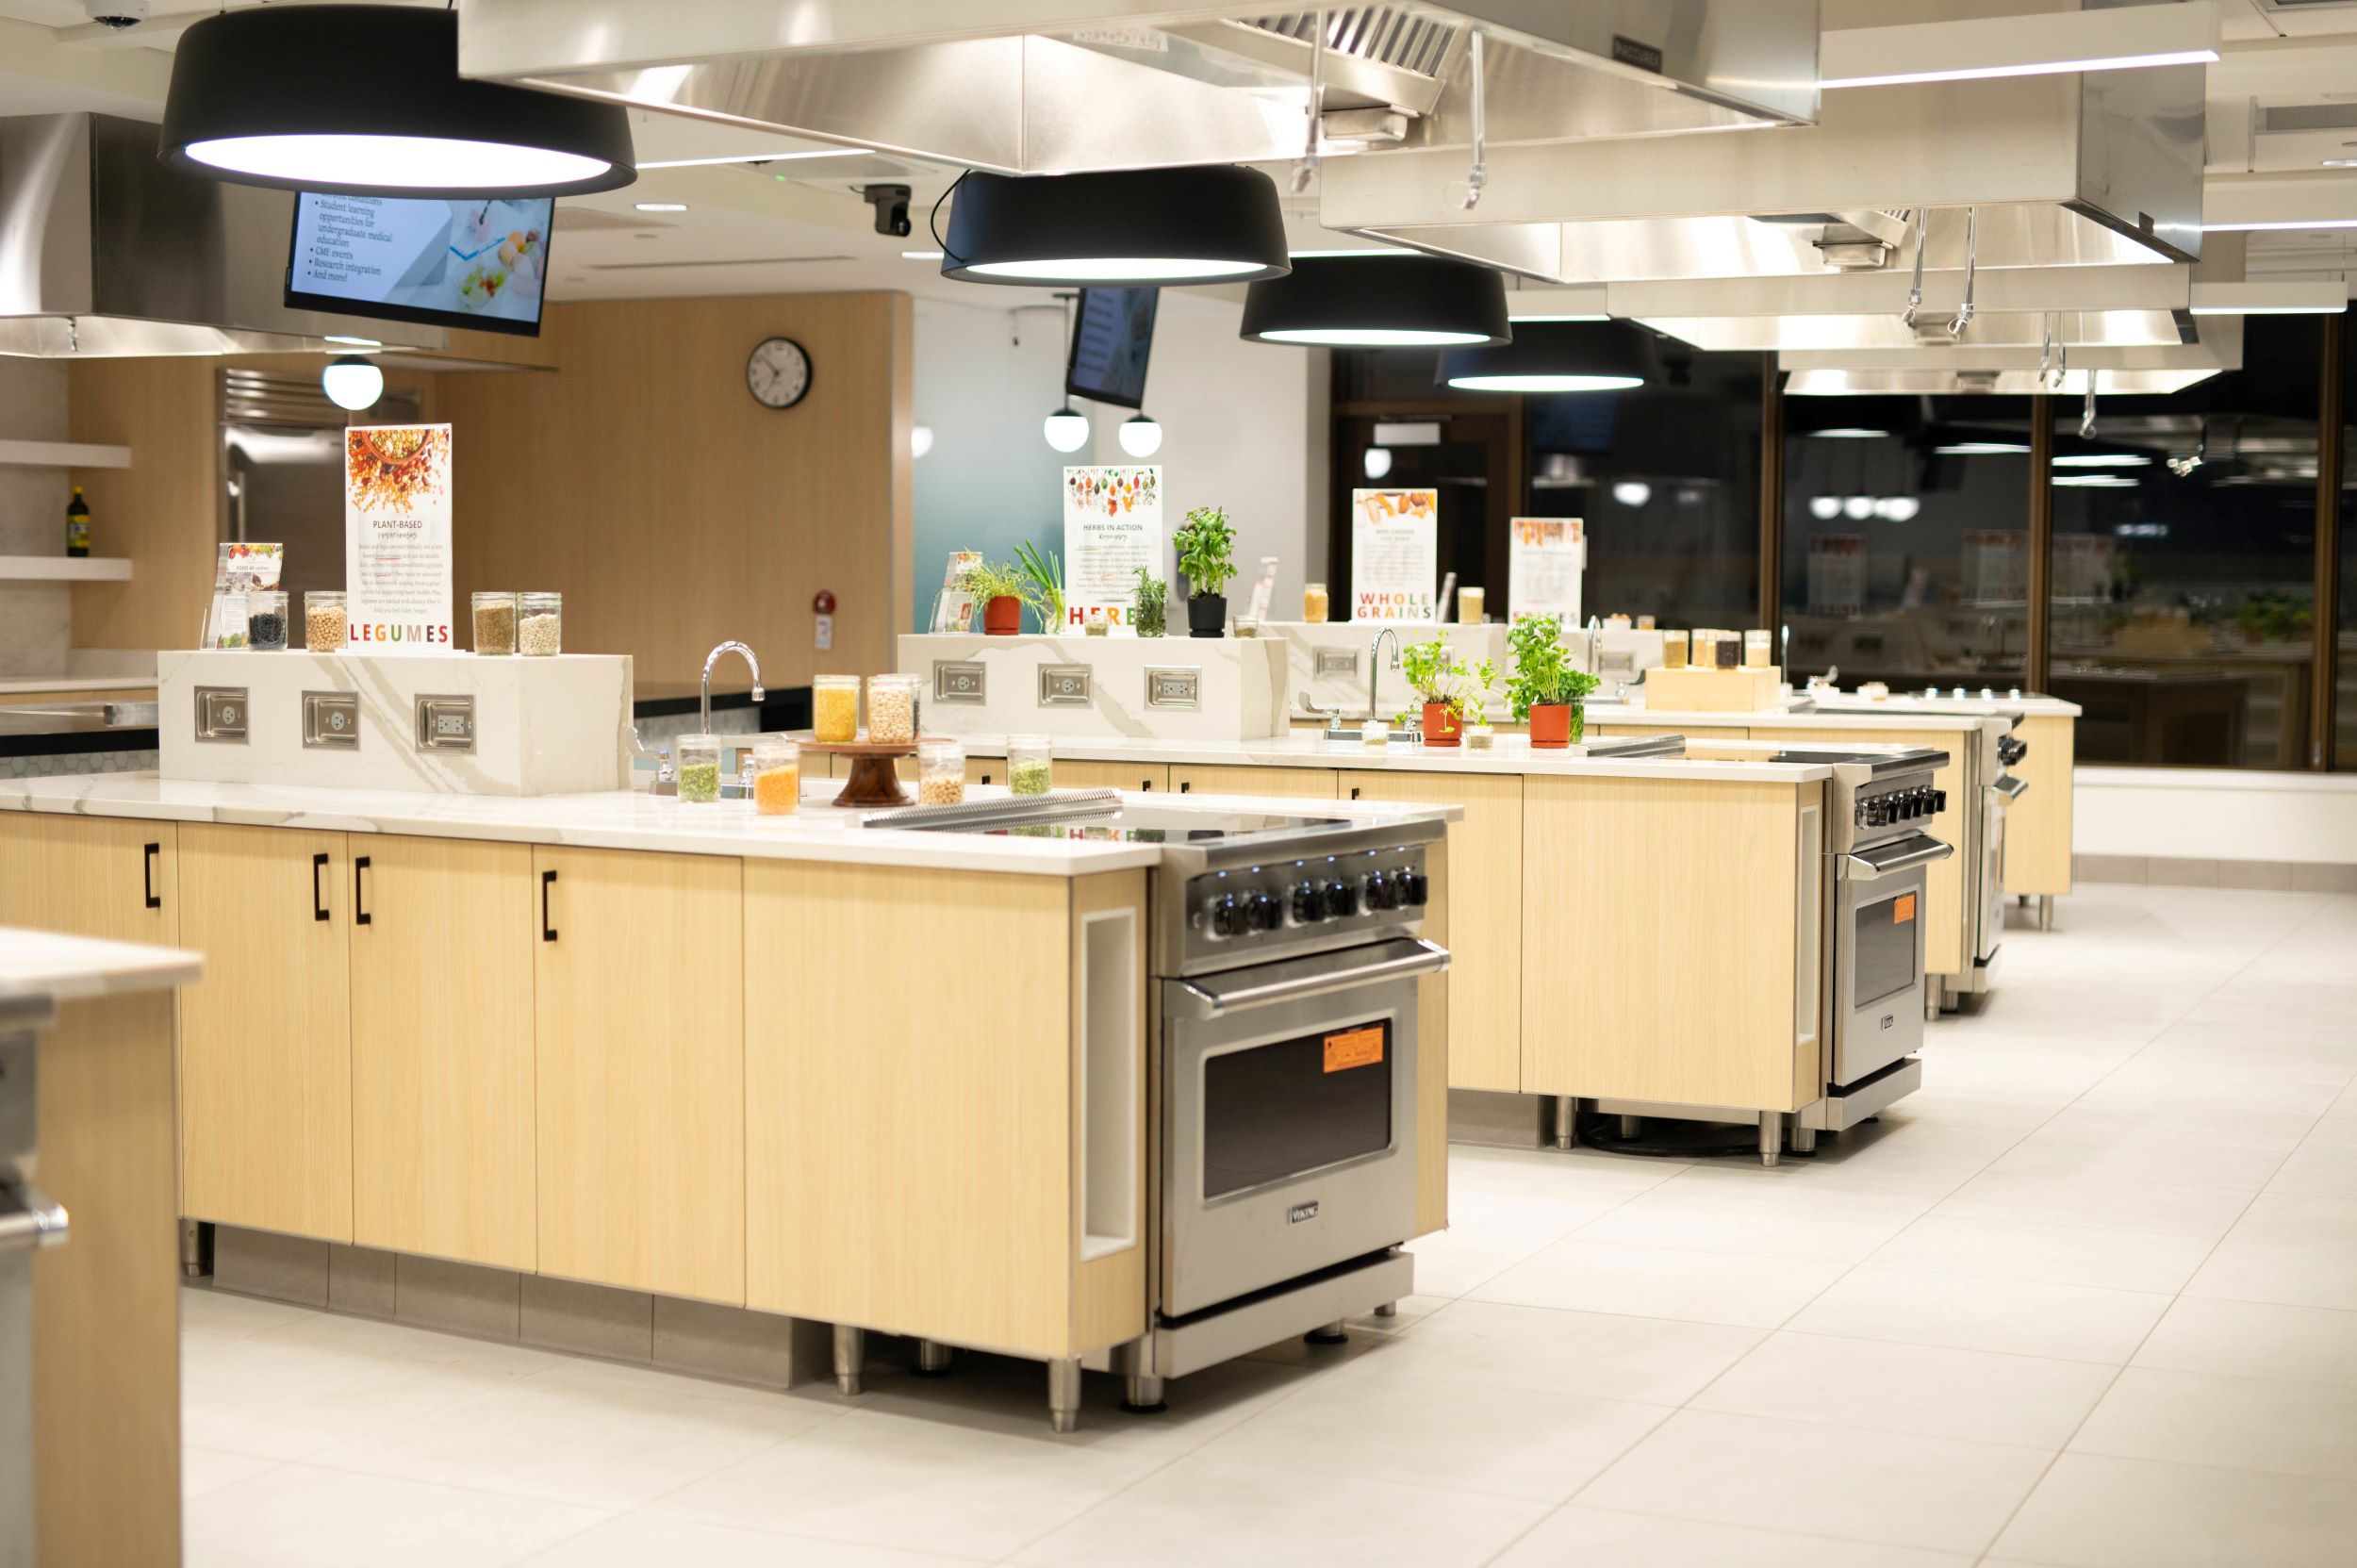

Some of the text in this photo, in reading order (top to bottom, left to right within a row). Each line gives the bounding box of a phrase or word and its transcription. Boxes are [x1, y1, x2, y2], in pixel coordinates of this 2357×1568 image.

[321, 200, 375, 219] Student learning
[319, 212, 375, 227] opportunities for
[318, 224, 392, 242] undergraduate medical
[317, 236, 350, 247] education
[316, 246, 354, 260] CME events
[314, 257, 382, 275] Research integration
[313, 270, 348, 282] And more!
[1360, 593, 1429, 604] WHOLE
[1357, 606, 1431, 619] GRAINS
[350, 623, 448, 643] LEGUMES
[1291, 1205, 1318, 1223] VIKING
